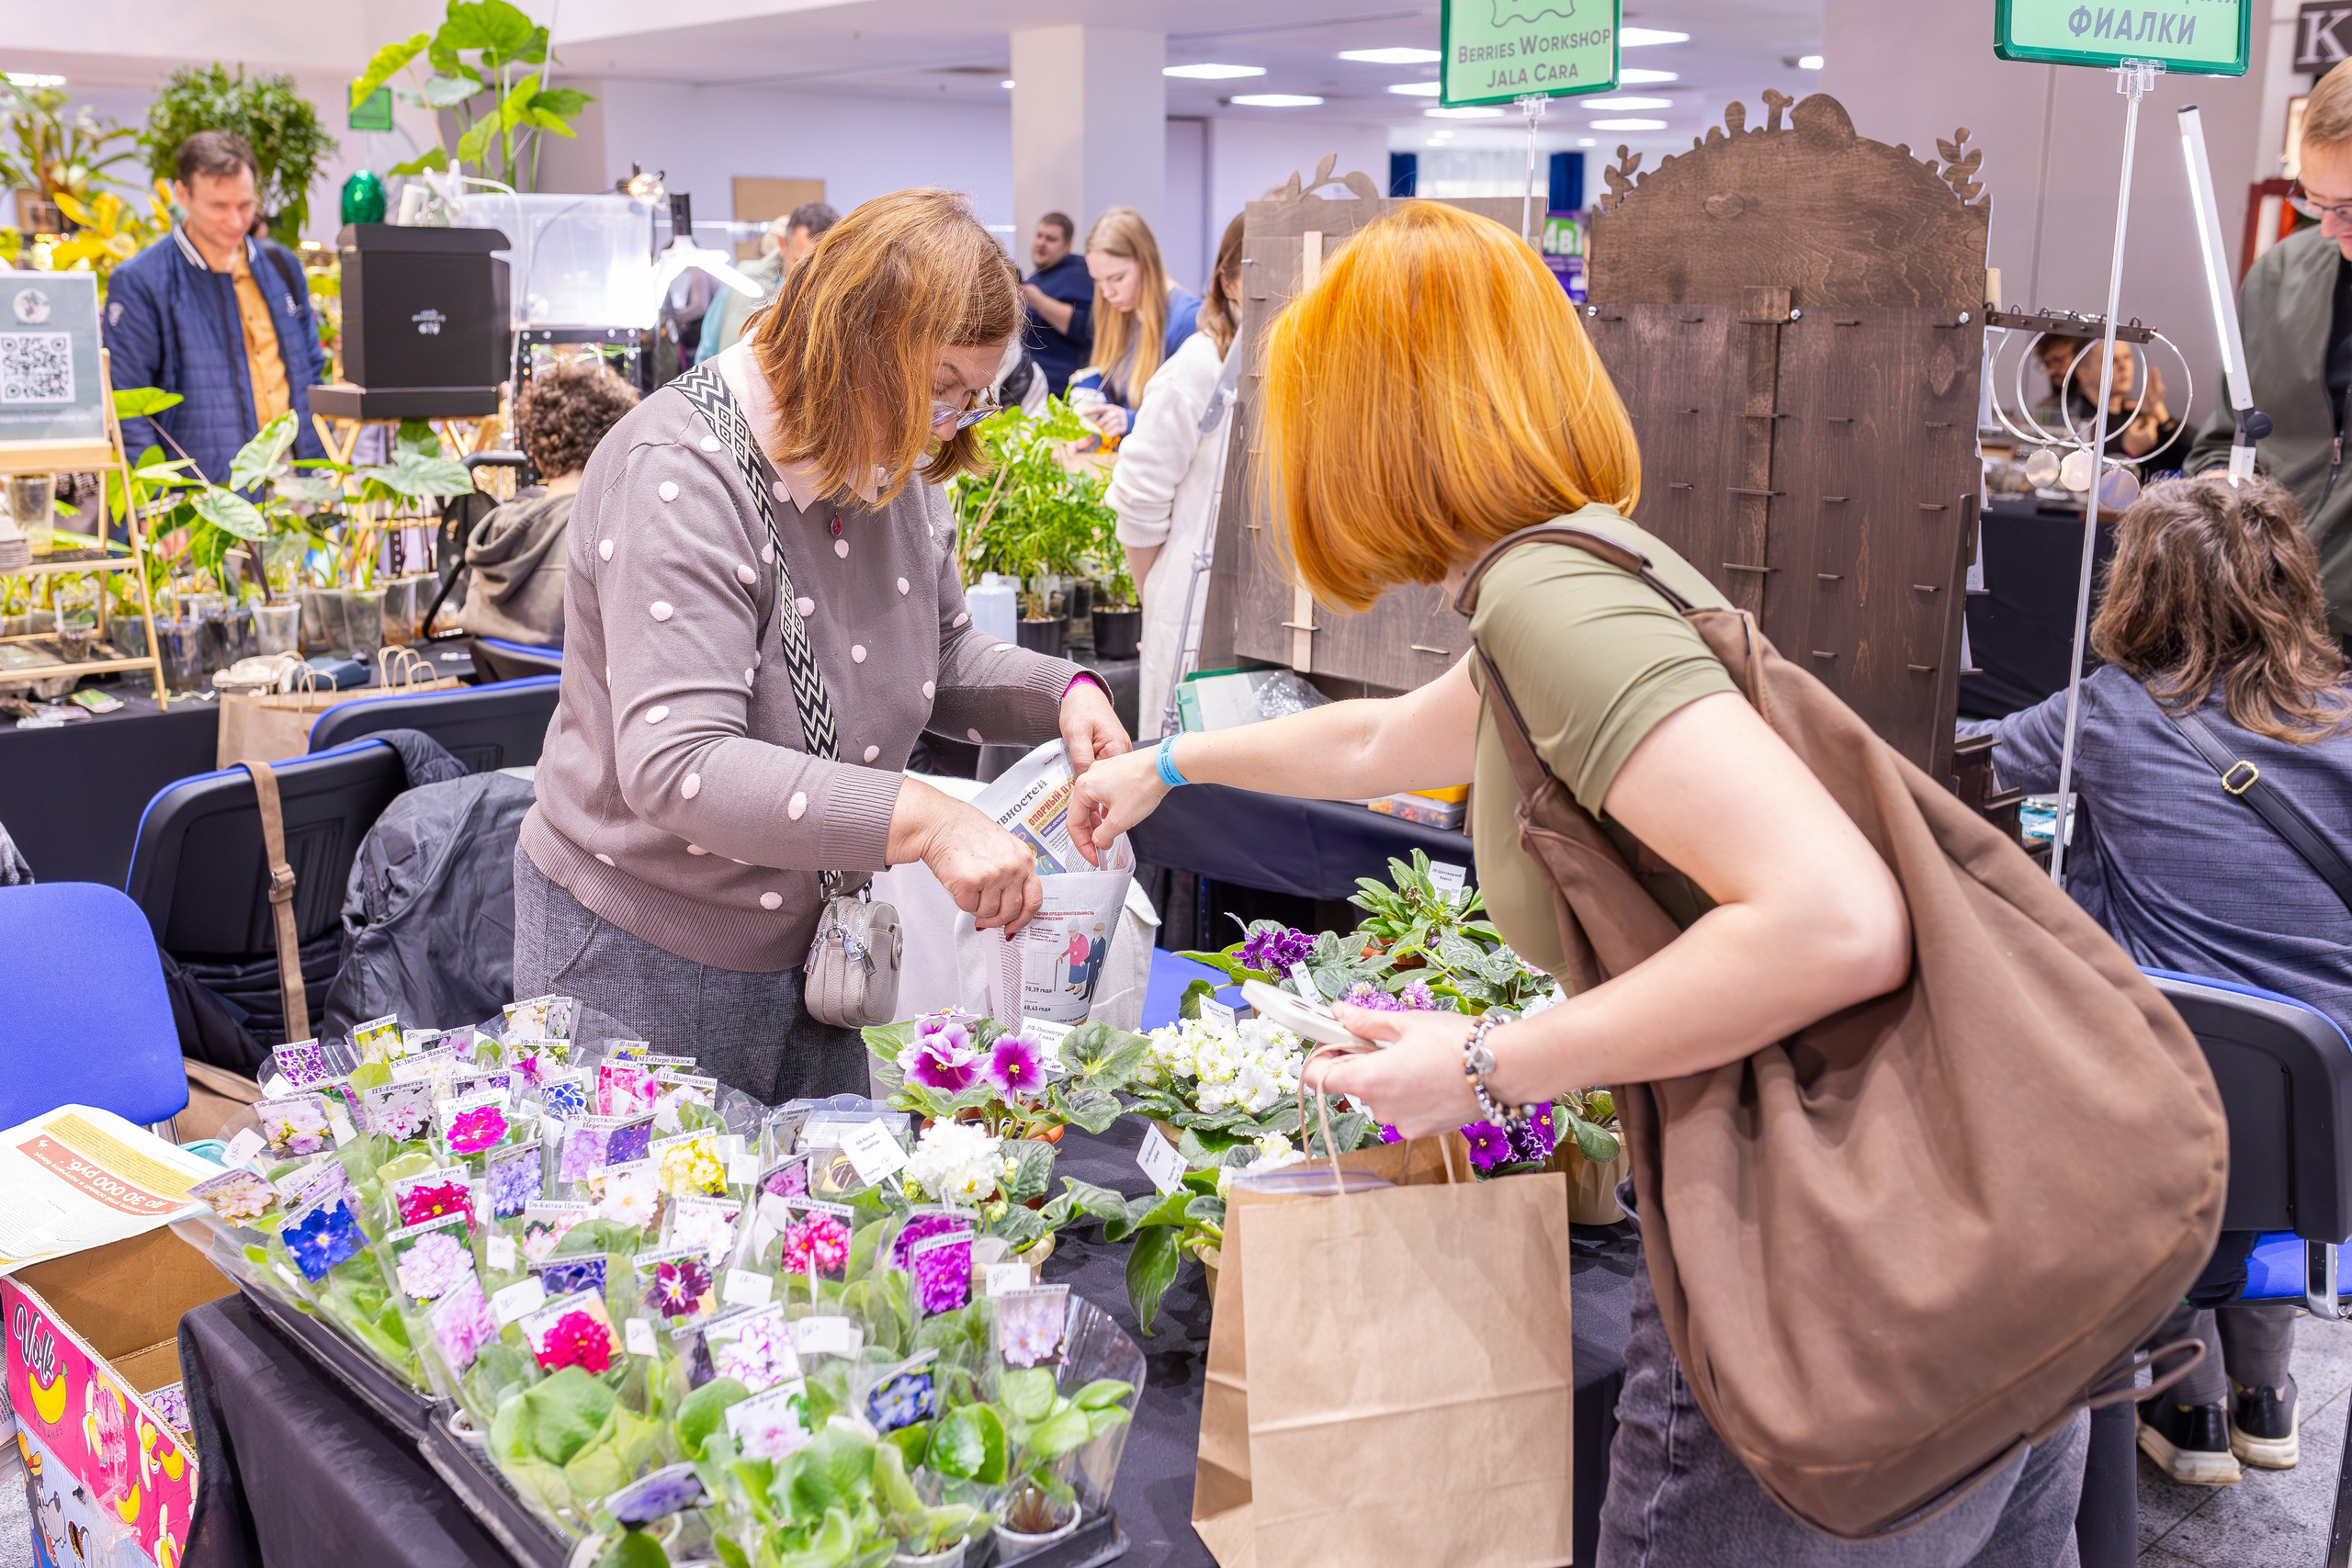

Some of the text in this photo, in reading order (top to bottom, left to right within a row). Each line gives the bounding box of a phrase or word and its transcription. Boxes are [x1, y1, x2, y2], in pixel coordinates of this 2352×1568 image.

[2068, 5, 2197, 45] ФИАЛКИ
[1487, 63, 1578, 88] JALA CARA
[1028, 789, 1063, 827] ОПОРНЫЙ
[1025, 1023, 1065, 1037] ЛФ-Посмотри
[1038, 1033, 1055, 1042] Глаза
[425, 1043, 452, 1059] Января
[450, 1067, 510, 1085] РМ-Розовые Маки
[661, 1072, 716, 1087] ЛЕ-Выпускница
[371, 1079, 424, 1095] ПТ-Генриетта
[93, 1175, 126, 1197] 000
[124, 1190, 147, 1206] 30
